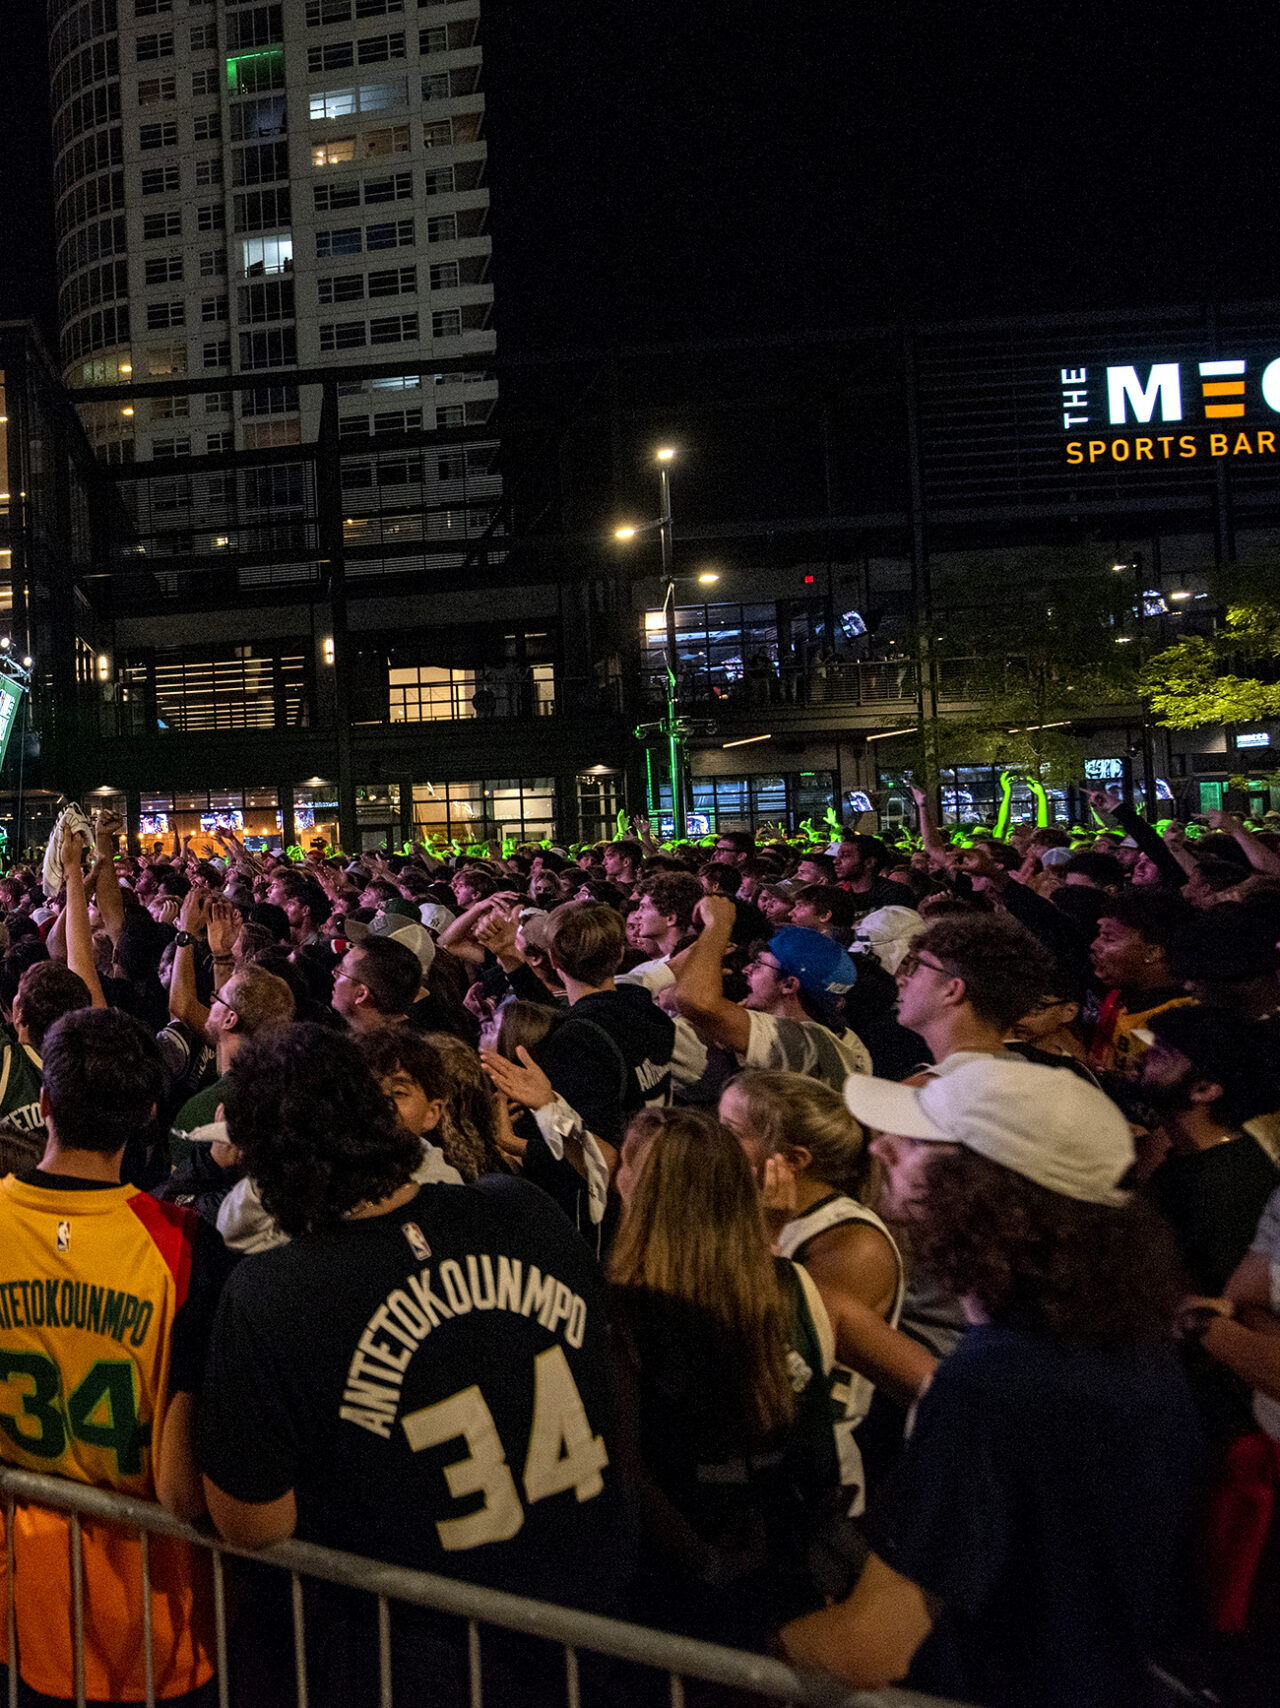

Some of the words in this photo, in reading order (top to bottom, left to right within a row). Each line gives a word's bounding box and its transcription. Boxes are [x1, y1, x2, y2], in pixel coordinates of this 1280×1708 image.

[1061, 367, 1089, 429] THE
[1066, 436, 1197, 464] SPORTS
[1209, 431, 1276, 456] BAR
[339, 1254, 587, 1439] ANTETOKOUNMPO
[402, 1344, 609, 1551] 34
